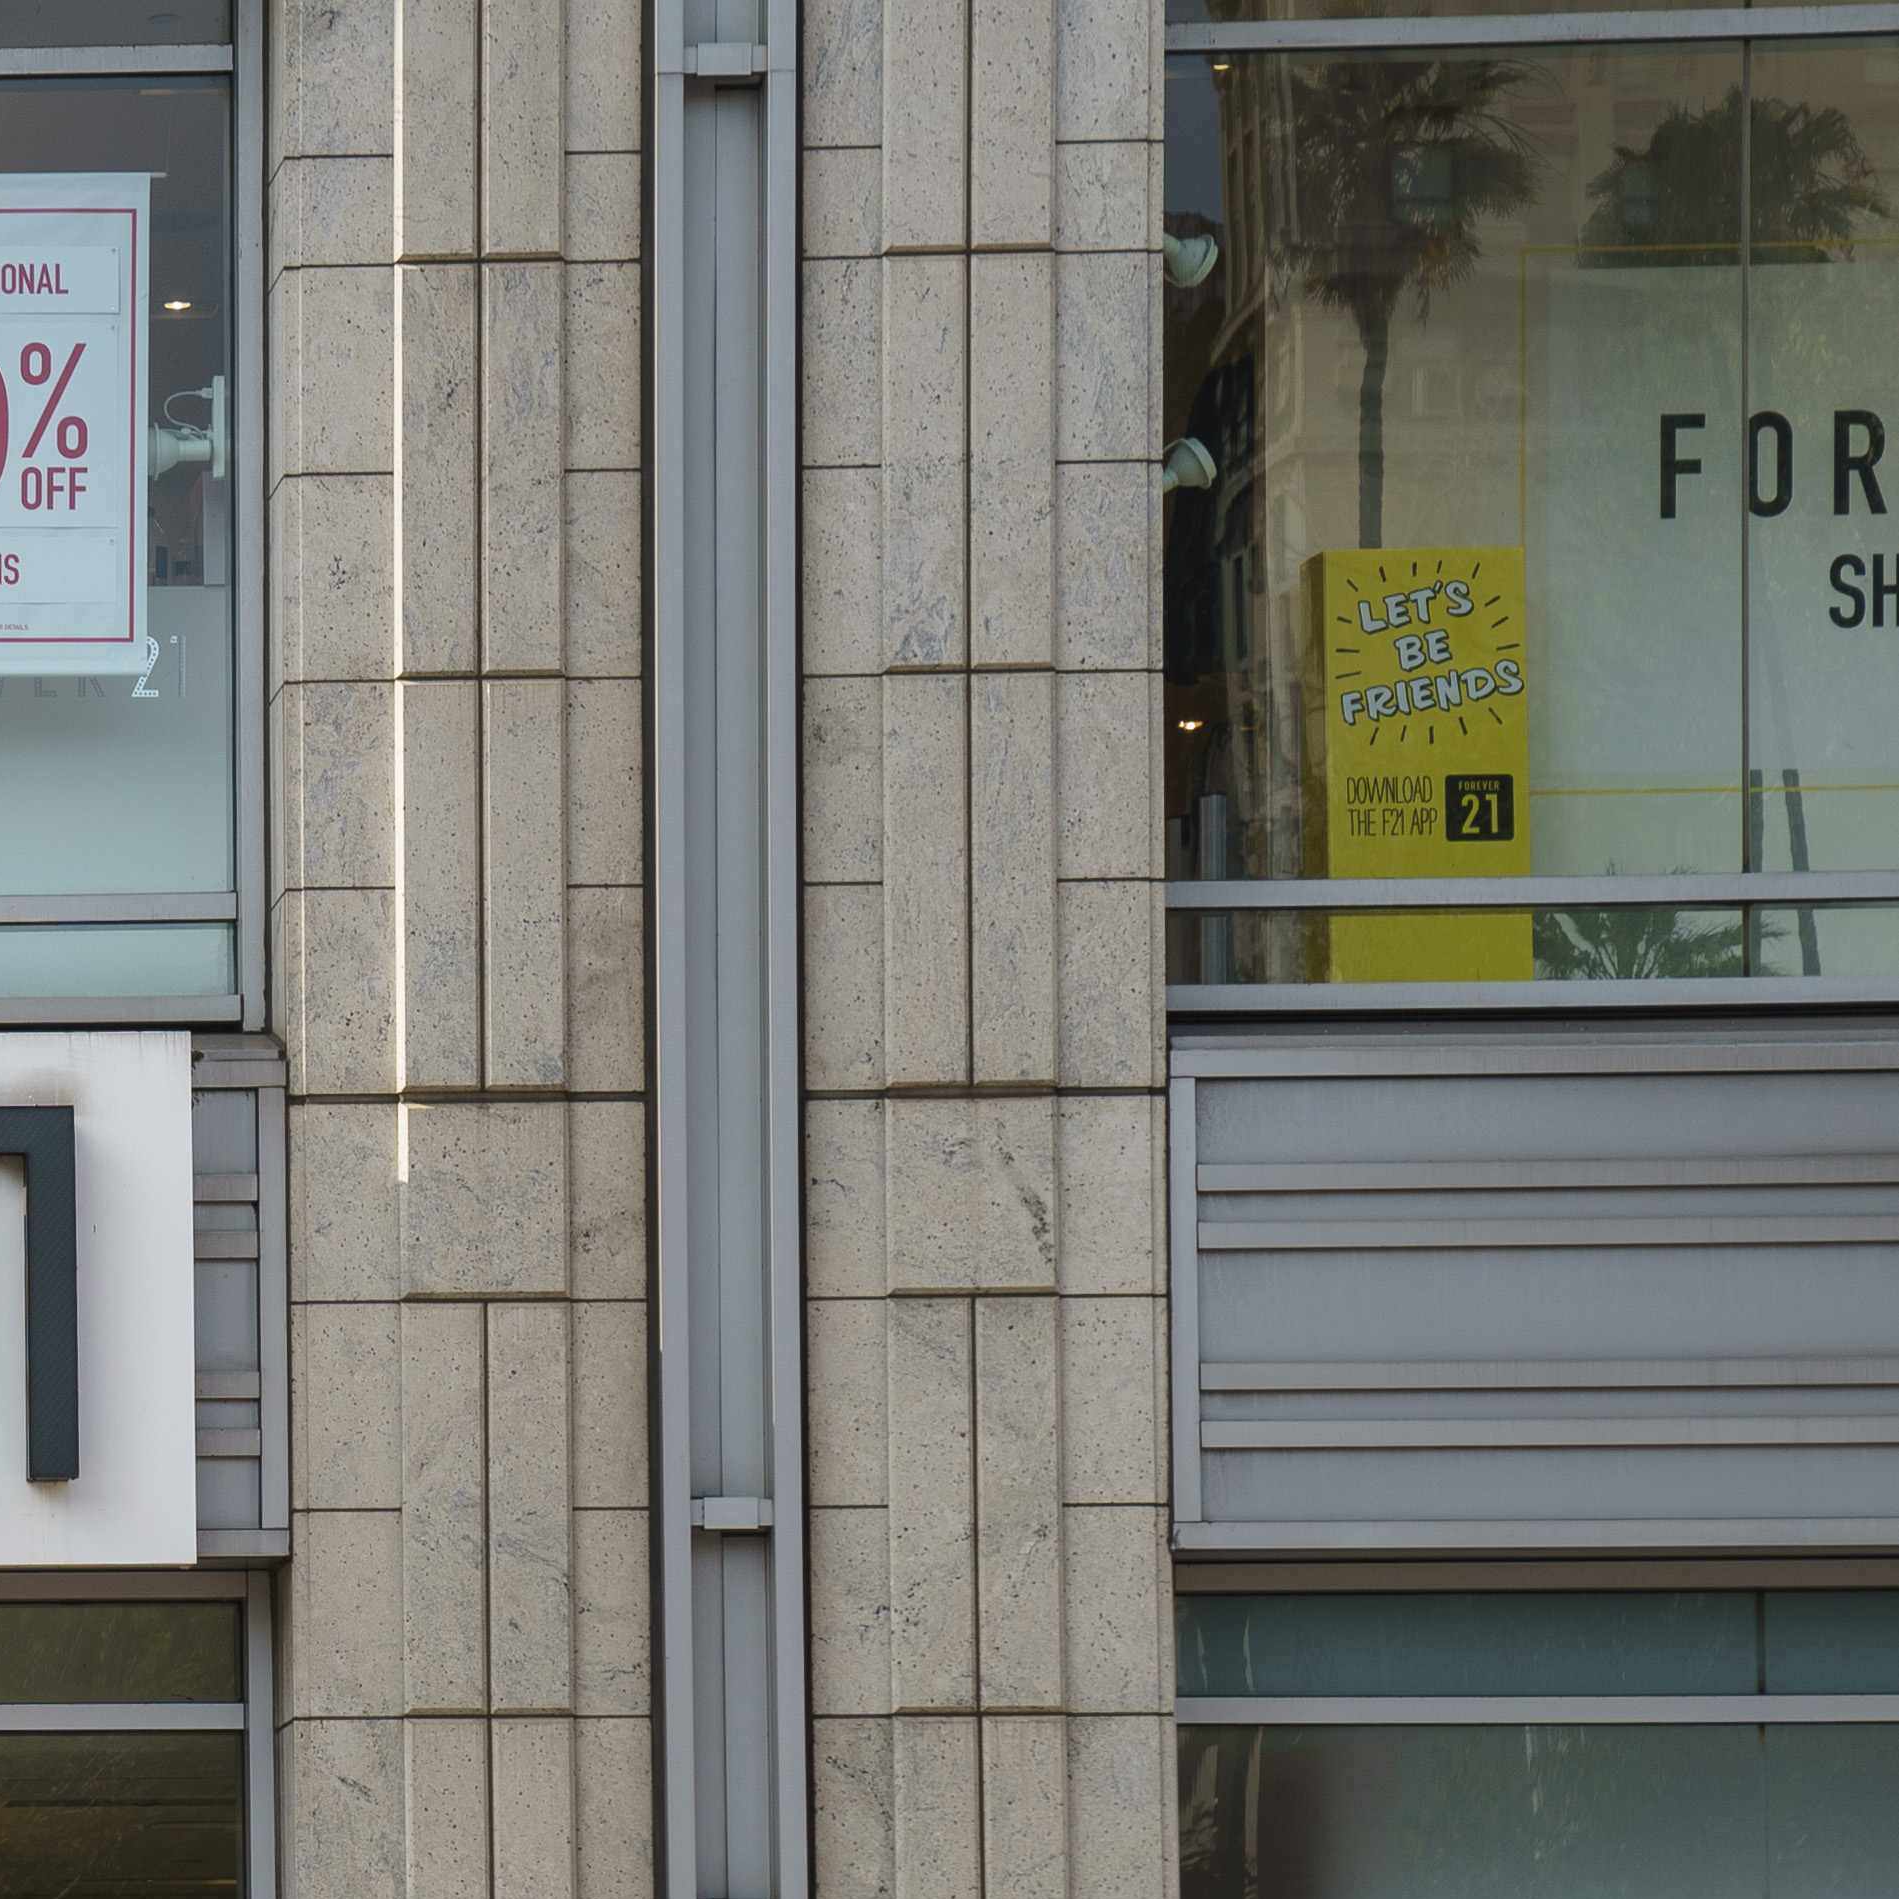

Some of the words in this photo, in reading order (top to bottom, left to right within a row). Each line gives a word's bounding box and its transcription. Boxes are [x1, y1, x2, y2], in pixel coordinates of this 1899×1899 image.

[21, 467, 88, 510] OFF
[1358, 580, 1474, 634] LET'S
[1394, 629, 1452, 672] BE
[1340, 659, 1524, 726] FRIENDS
[1346, 775, 1433, 804] DOWNLOAD
[1458, 781, 1500, 792] FOREVER
[1348, 808, 1377, 836] THE
[1410, 807, 1438, 836] APP
[1461, 794, 1499, 834] 21
